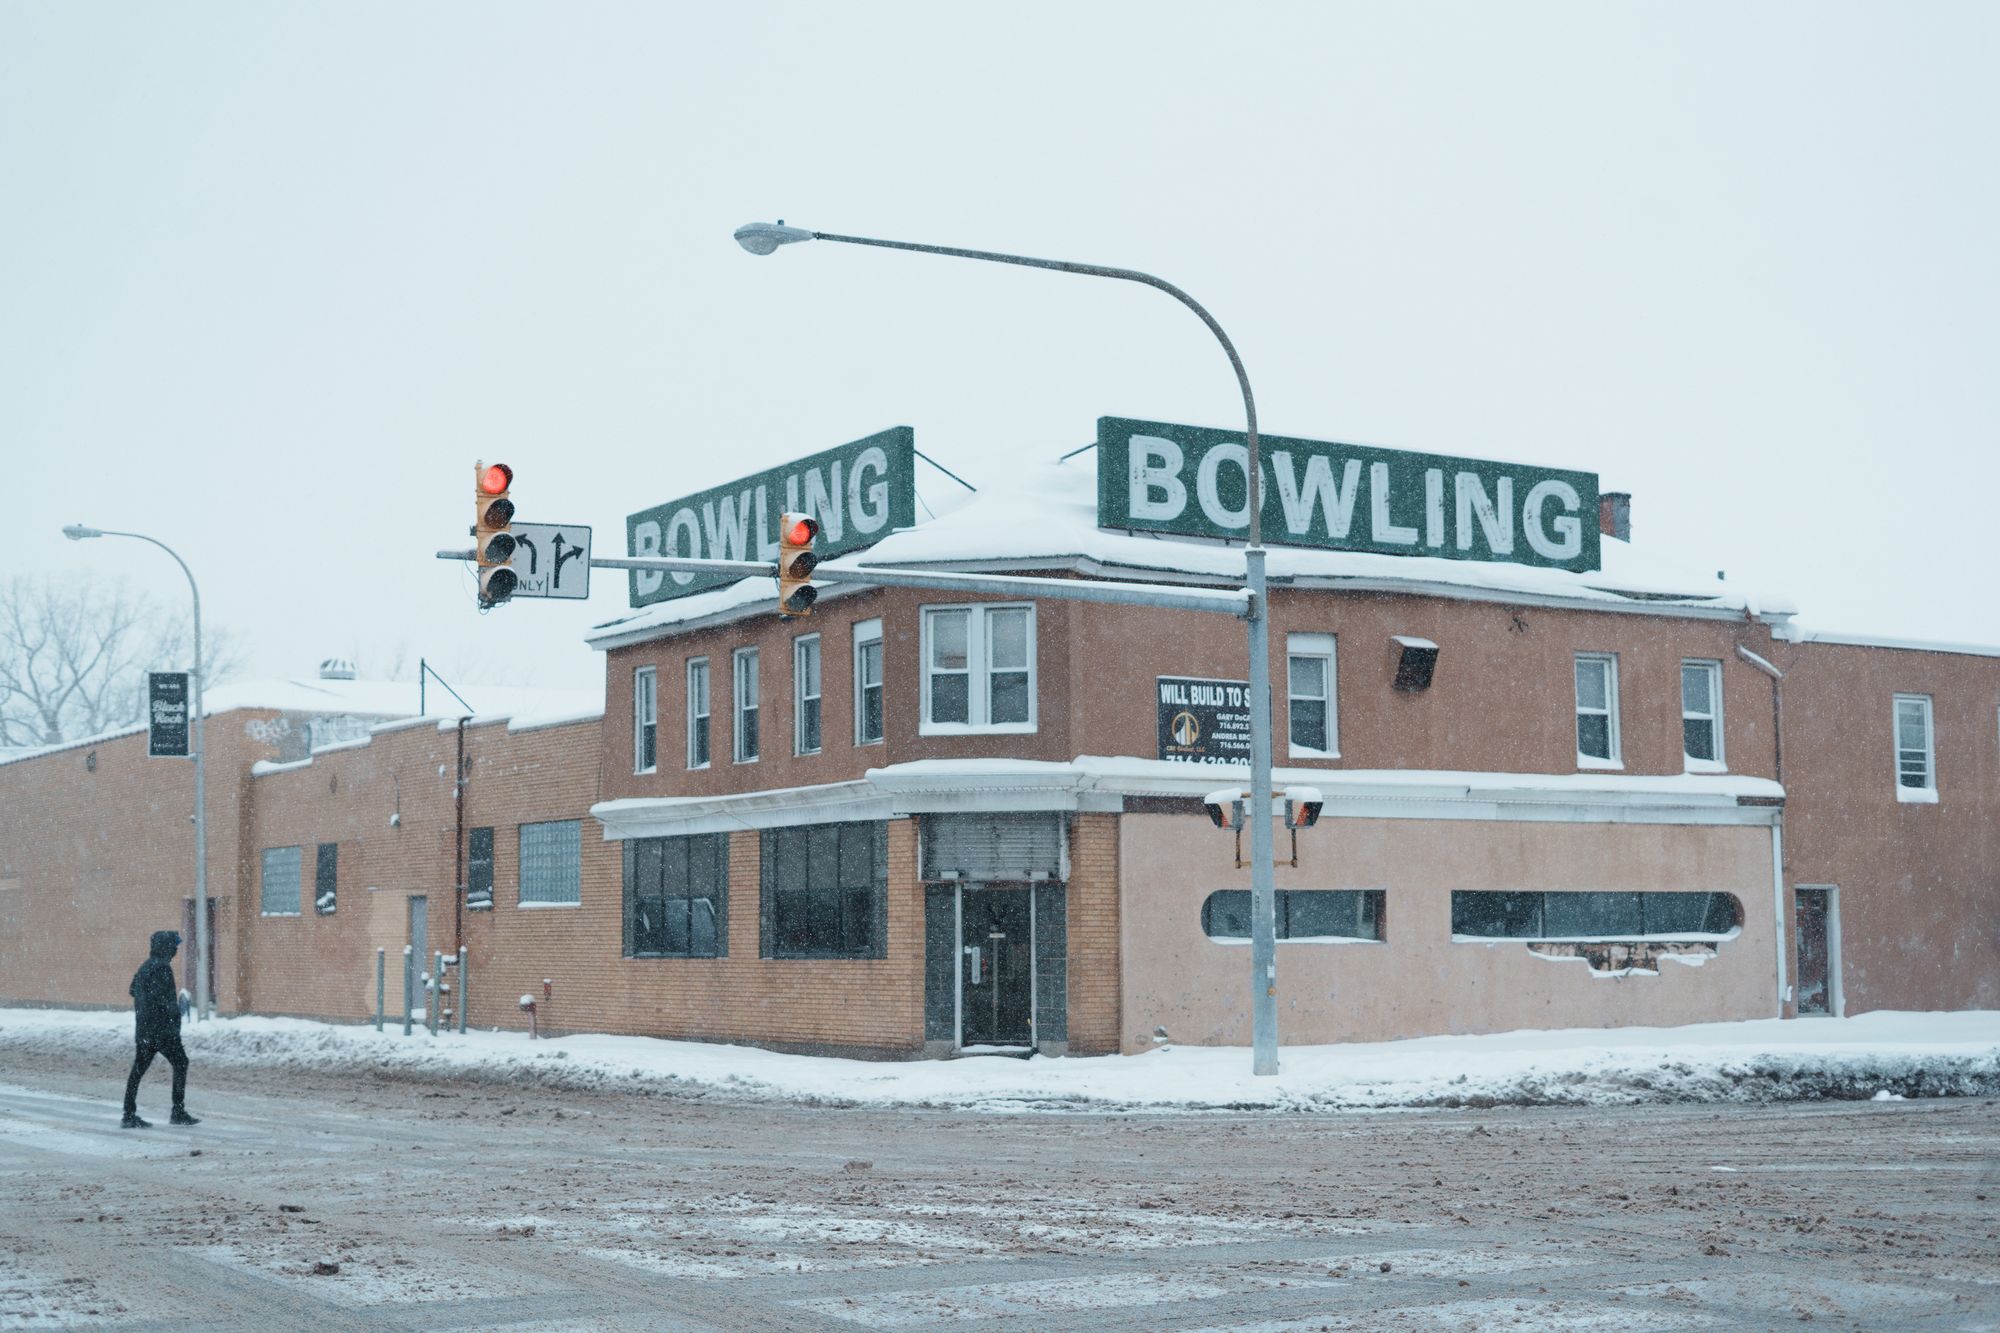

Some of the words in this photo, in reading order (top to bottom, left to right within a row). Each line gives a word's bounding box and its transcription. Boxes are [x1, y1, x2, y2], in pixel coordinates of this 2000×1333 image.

[1128, 434, 1582, 560] BOWLING
[635, 446, 889, 597] BOWLING
[1160, 684, 1188, 704] WILL
[1191, 686, 1224, 706] BUILD
[1226, 687, 1242, 707] TO
[152, 700, 185, 712] Black
[154, 712, 183, 724] Rock
[1216, 713, 1233, 721] GARY
